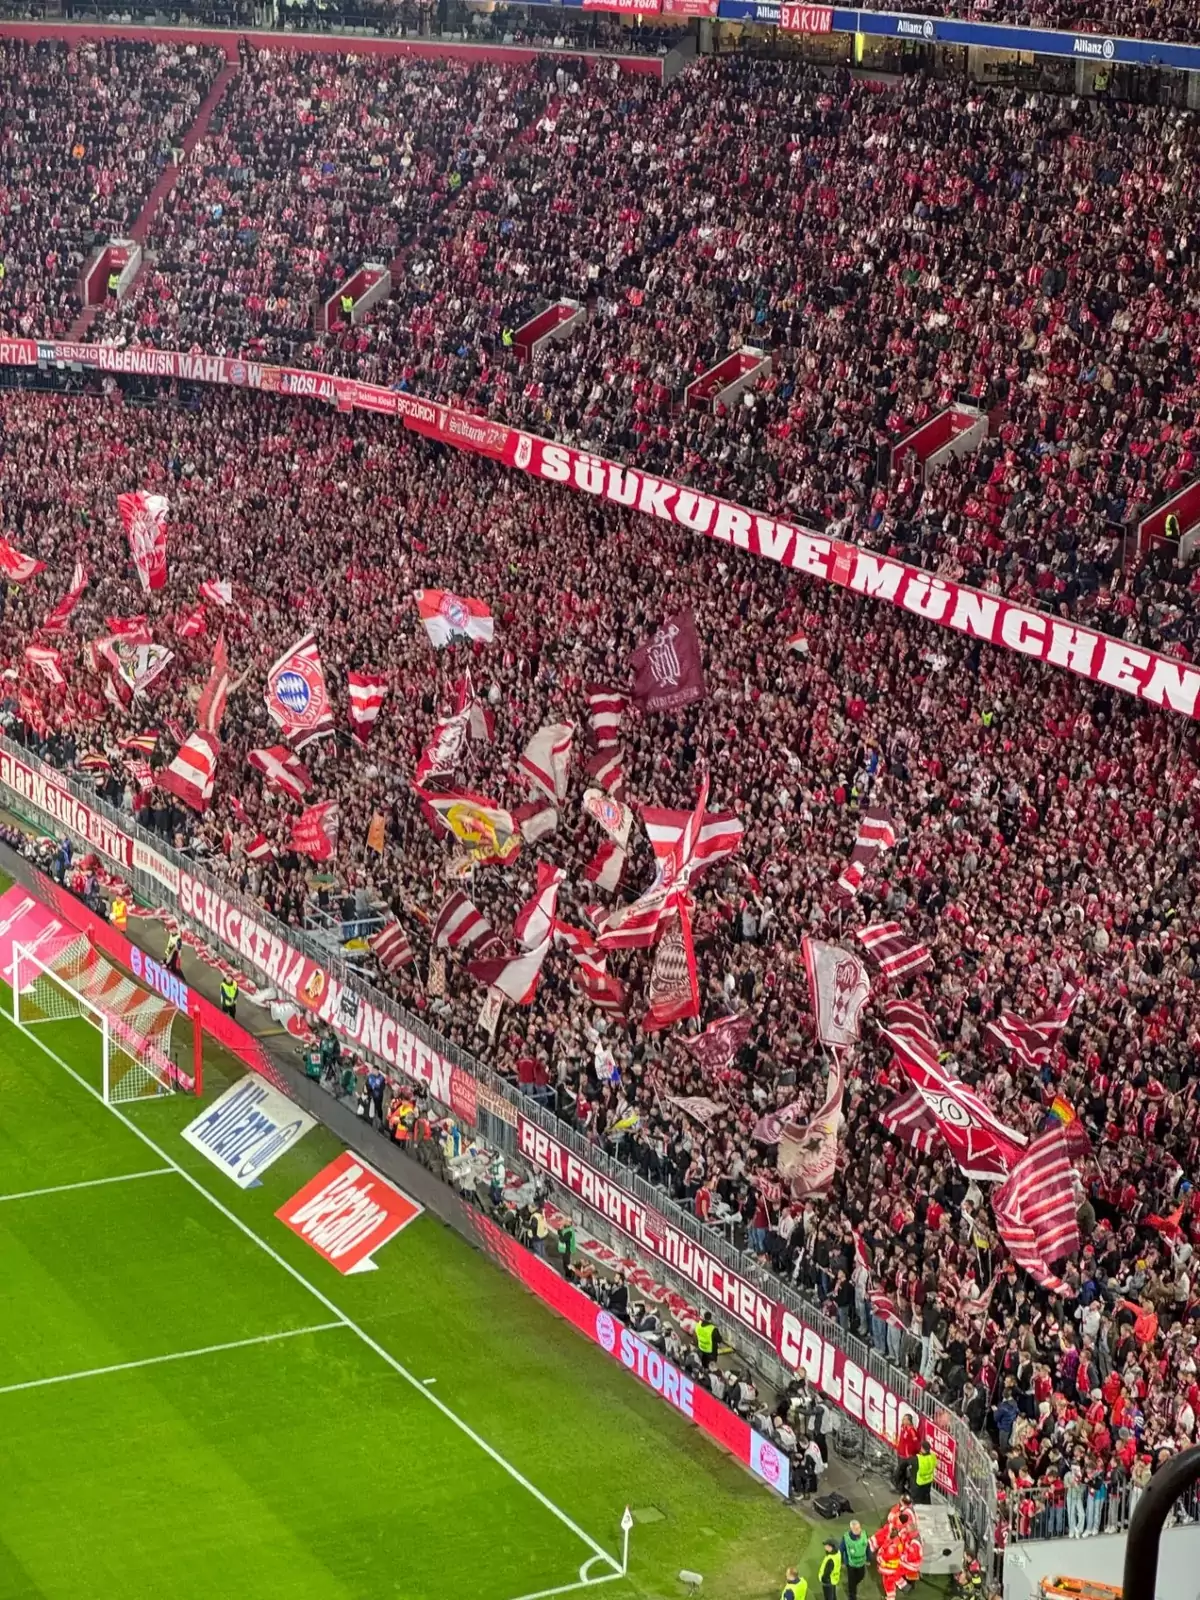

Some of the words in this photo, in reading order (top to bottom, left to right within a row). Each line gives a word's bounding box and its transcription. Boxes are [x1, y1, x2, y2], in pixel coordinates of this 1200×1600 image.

[782, 7, 831, 31] BAKUM
[897, 20, 923, 34] Allianz
[1073, 39, 1102, 55] Allianz
[56, 346, 98, 360] SENZIG
[99, 347, 175, 374] RABENAU/SN
[541, 445, 831, 578] SÜDKURVE
[851, 554, 1200, 716] MÜNCHEN
[181, 872, 306, 997] SCHICKERIA
[145, 956, 189, 1013] STORE
[190, 1079, 278, 1167] Allianz
[620, 1327, 695, 1418] STORE
